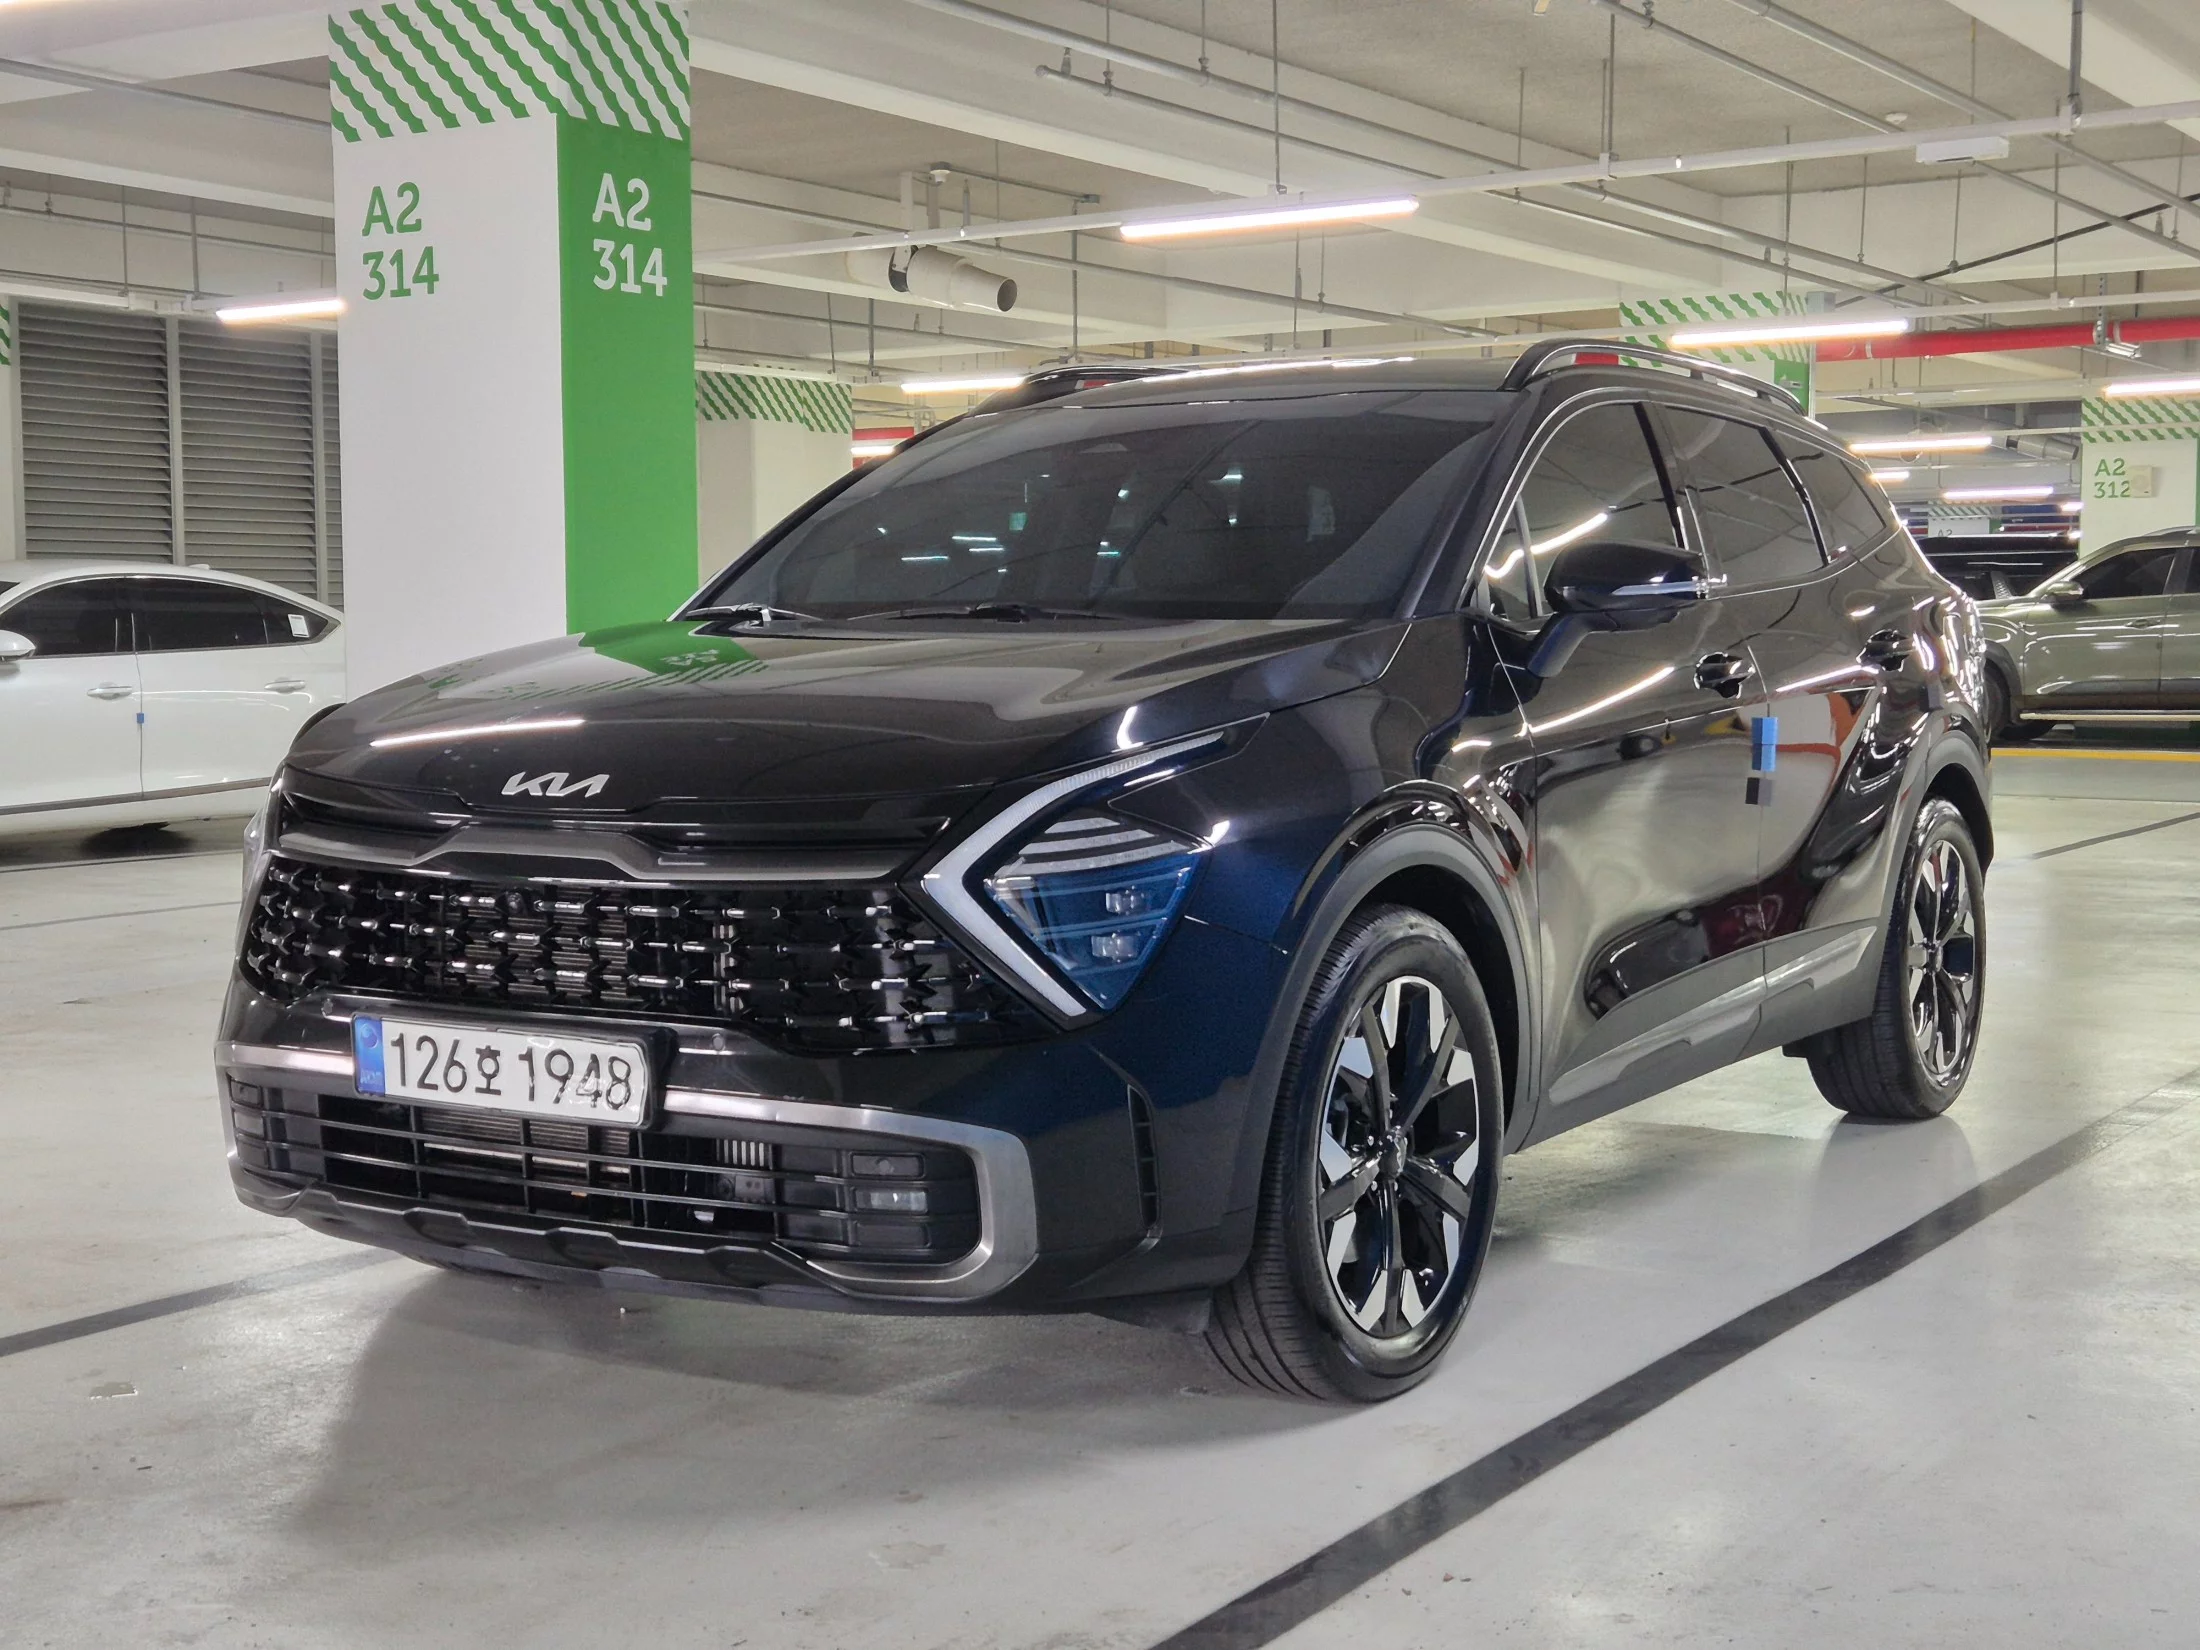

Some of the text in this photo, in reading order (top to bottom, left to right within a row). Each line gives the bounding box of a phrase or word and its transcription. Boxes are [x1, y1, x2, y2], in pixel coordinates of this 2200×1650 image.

[361, 181, 422, 237] A2
[592, 173, 651, 232] A2
[362, 246, 440, 300] 314
[593, 239, 668, 297] 314
[2093, 480, 2131, 499] 312
[2094, 457, 2126, 477] A2
[501, 771, 610, 798] KIA
[390, 1032, 632, 1111] 126호 1948
